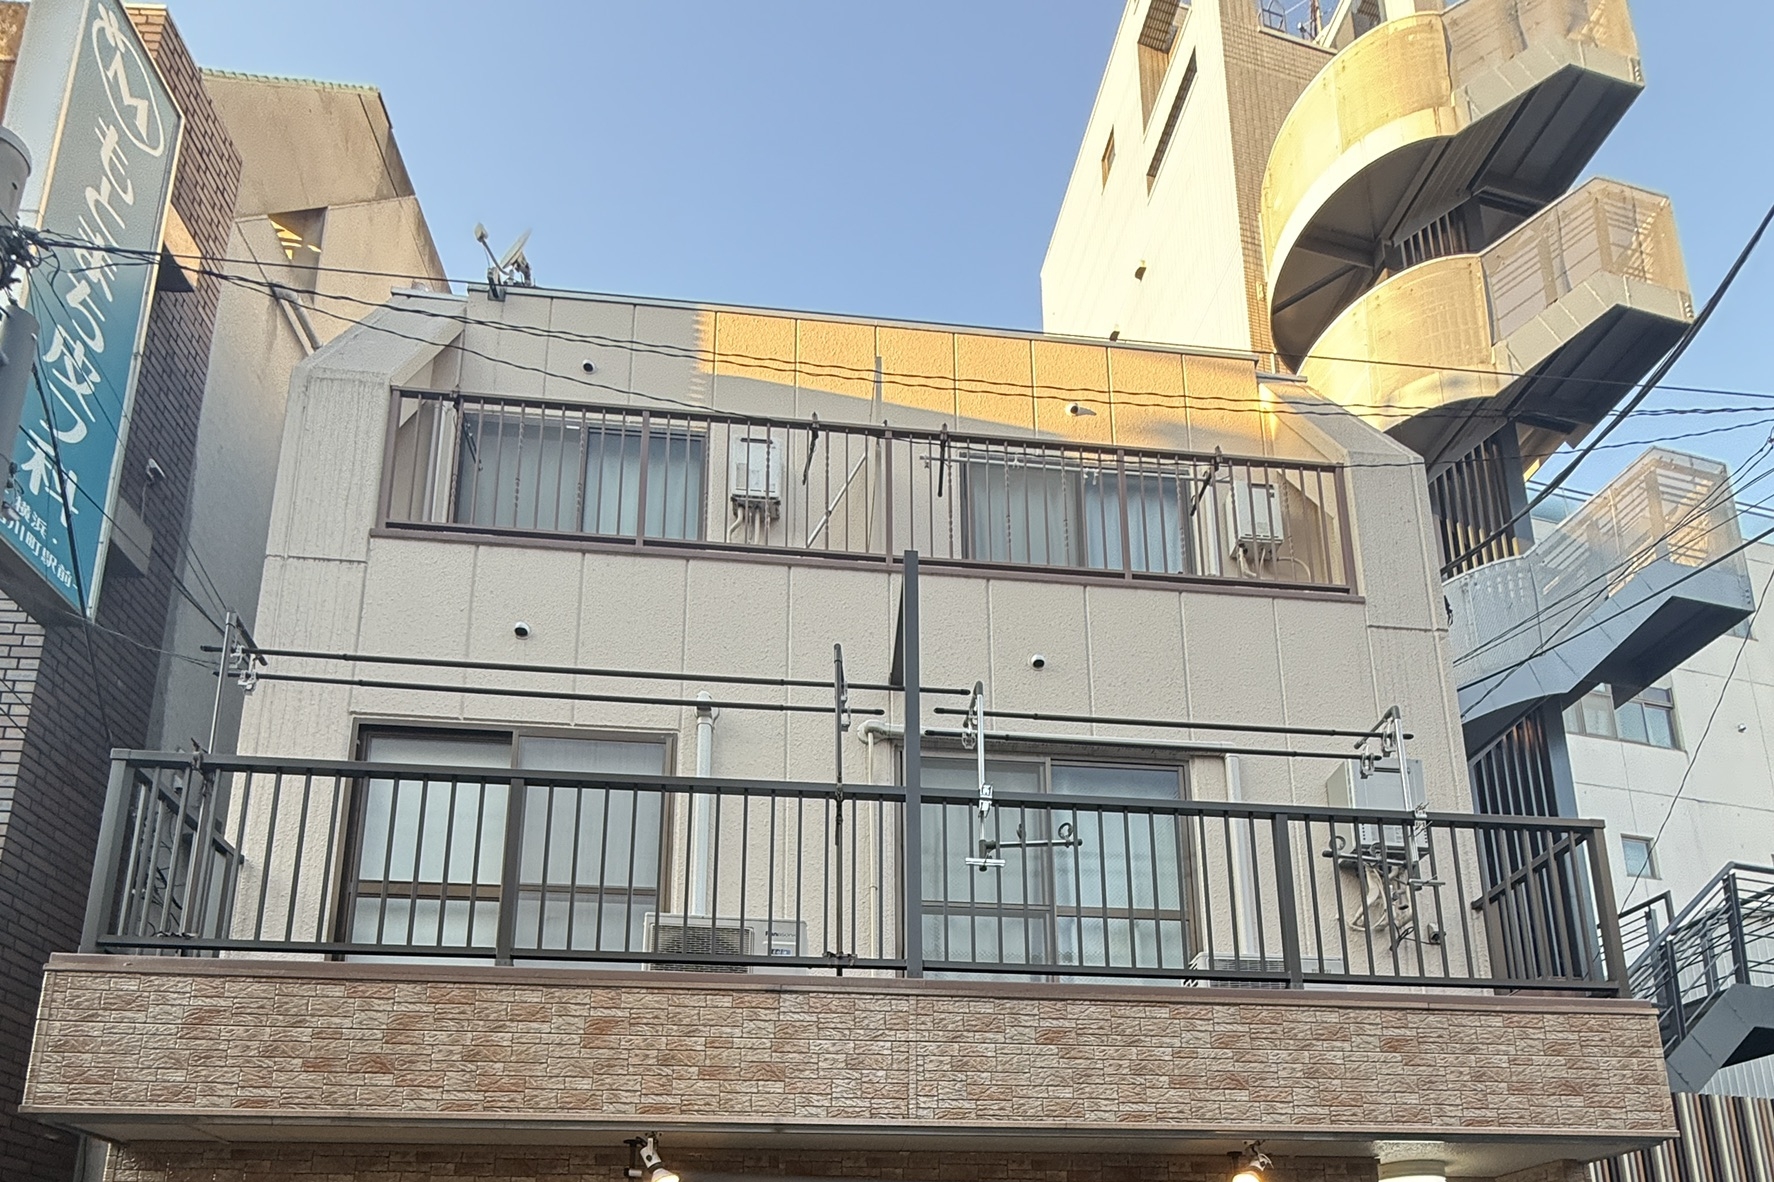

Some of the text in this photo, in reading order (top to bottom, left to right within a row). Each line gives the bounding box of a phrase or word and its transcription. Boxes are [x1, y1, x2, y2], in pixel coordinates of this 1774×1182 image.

[21, 117, 134, 527] もとまち皮フ科
